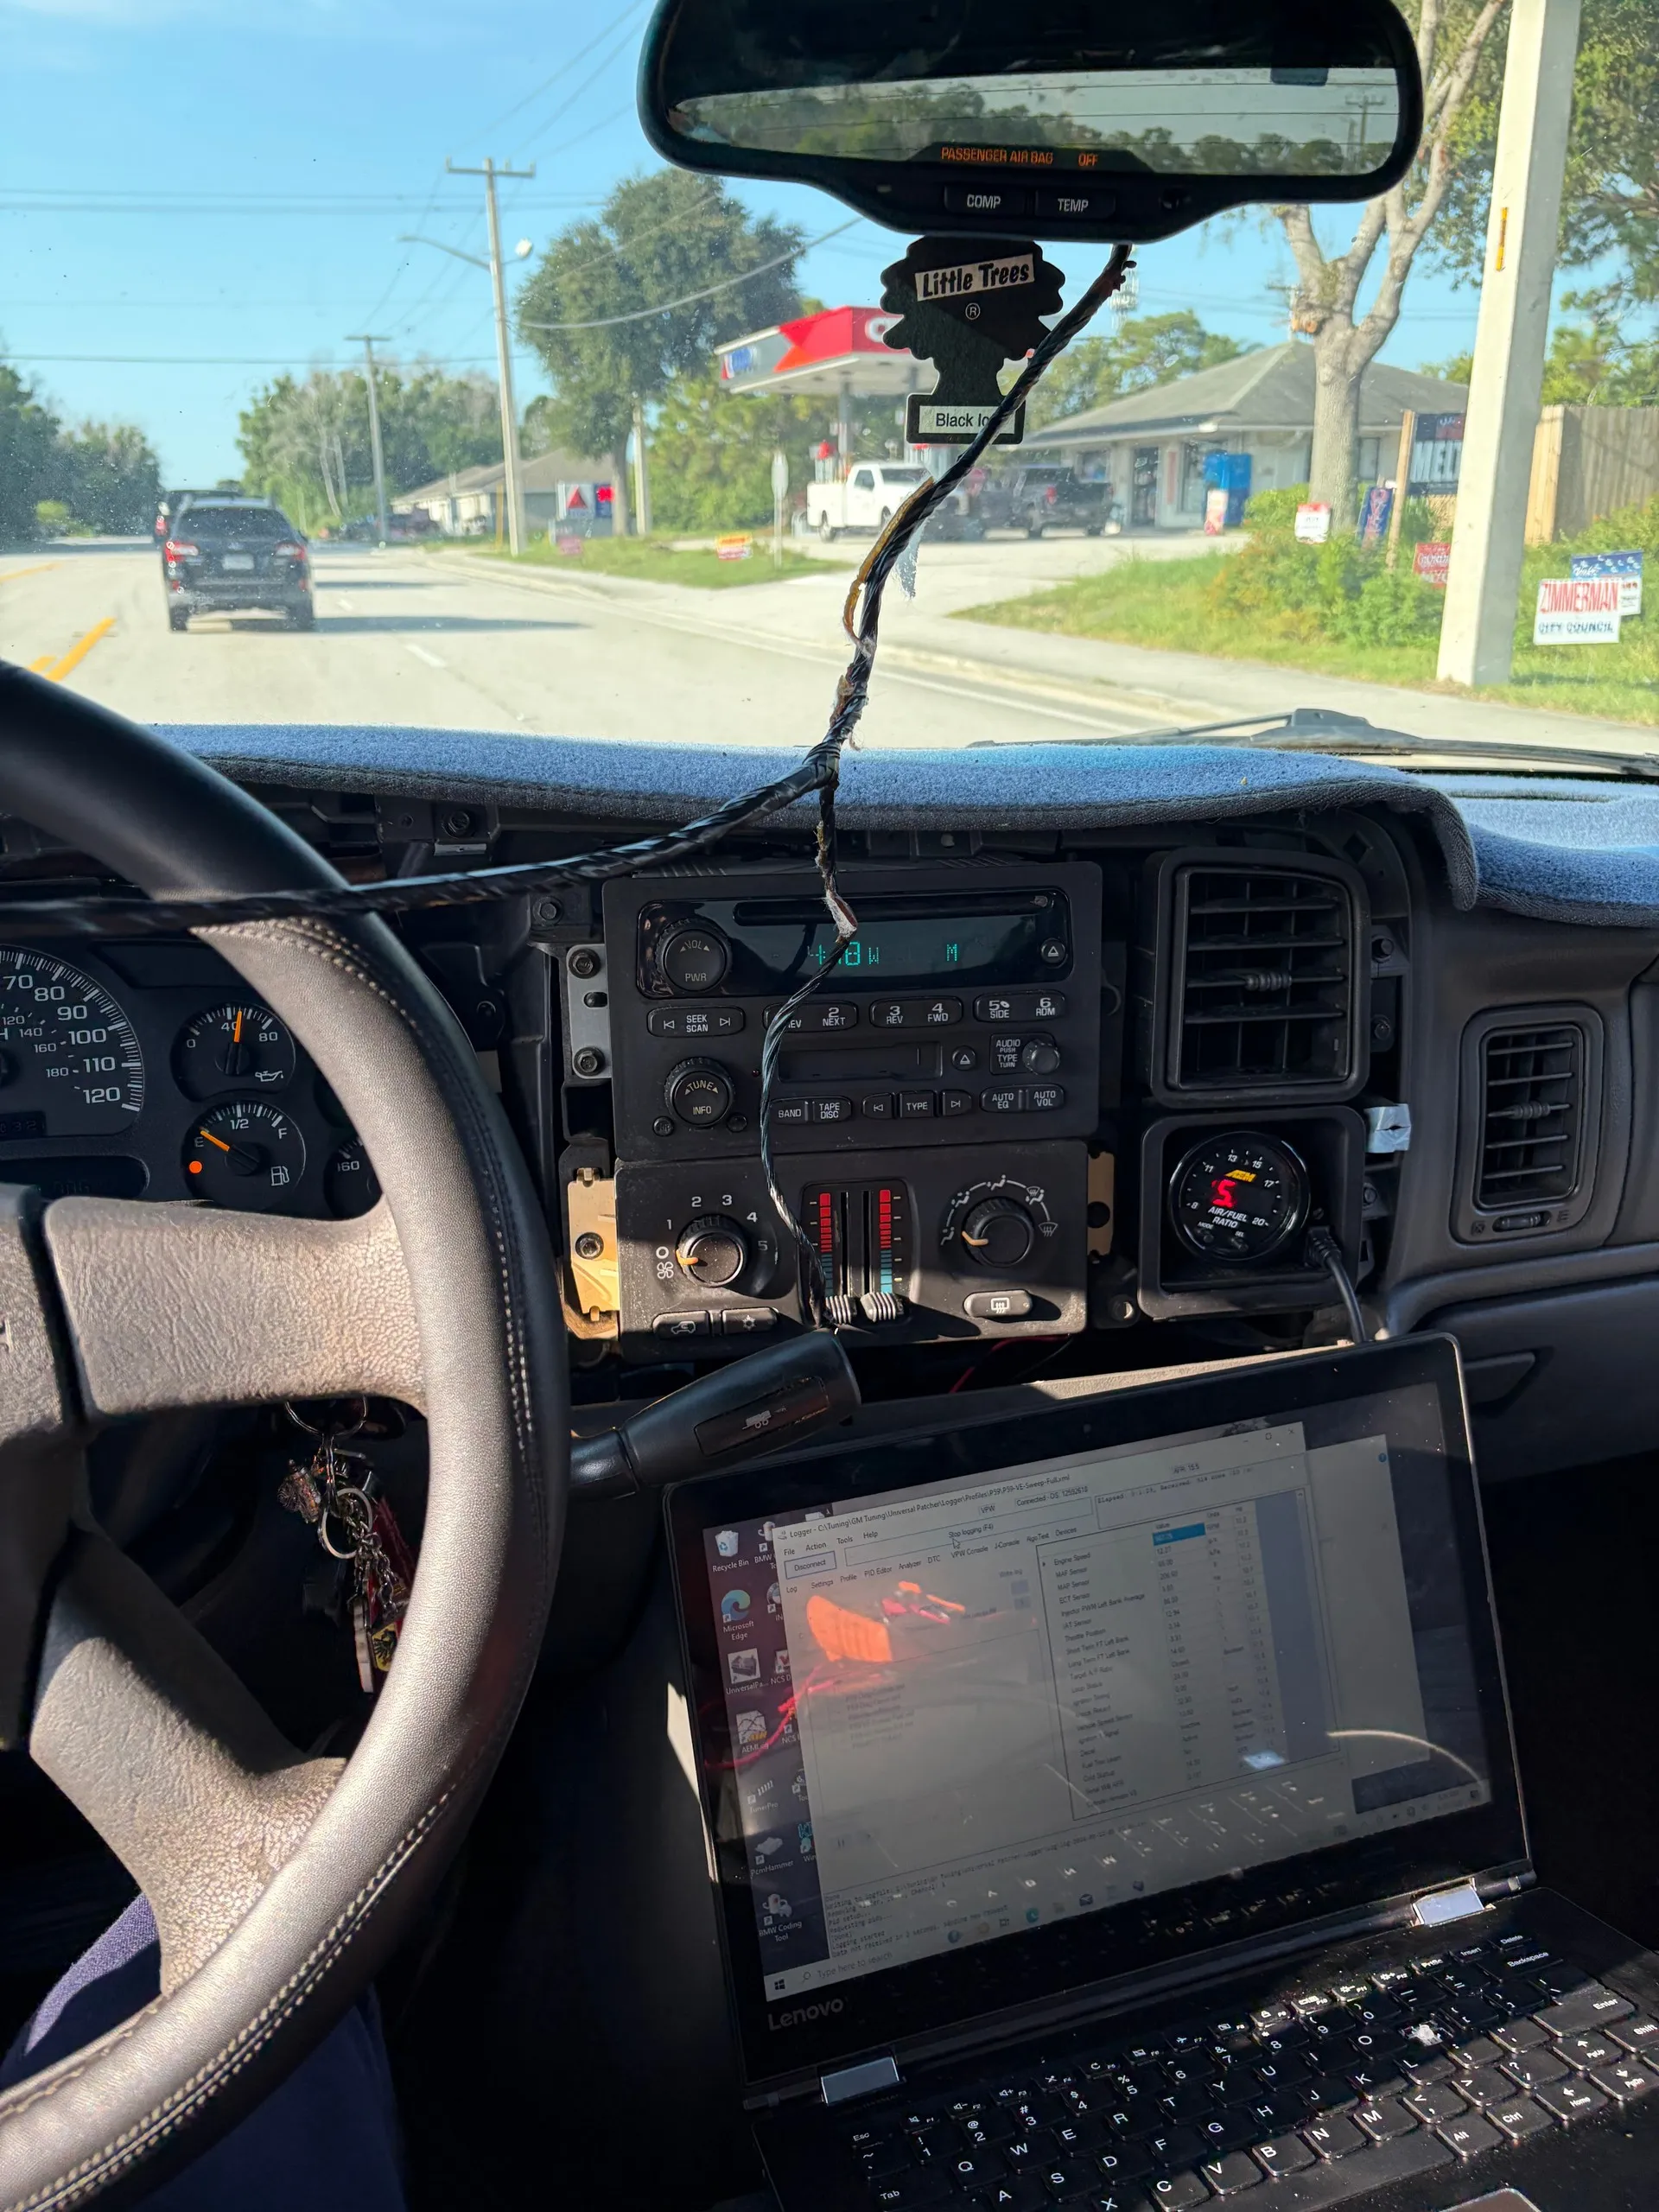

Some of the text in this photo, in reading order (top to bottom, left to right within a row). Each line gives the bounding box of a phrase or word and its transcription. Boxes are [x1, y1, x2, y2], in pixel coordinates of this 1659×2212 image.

[941, 146, 1099, 167] PASSENGER AIR BAG OFF
[966, 194, 1001, 209] COMP
[1057, 198, 1089, 213] TEMP
[923, 263, 1030, 298] Little Trees
[936, 412, 974, 427] Black
[1540, 581, 1619, 614] ZIMMERMAN
[1539, 620, 1615, 635] CITY COUNCIL
[684, 939, 702, 950] VOL
[3, 975, 34, 990] 70
[684, 973, 707, 982] PWR
[34, 986, 65, 1001] 80
[988, 1000, 1000, 1011] 5
[1039, 997, 1052, 1008] 6
[57, 1005, 88, 1020] 90
[828, 1007, 840, 1018] 2
[889, 1006, 901, 1016] 3
[931, 1003, 944, 1014] 4
[1036, 1008, 1056, 1017] RDM
[686, 1014, 707, 1023] SEEK
[886, 1015, 904, 1025] REV
[927, 1013, 949, 1023] FWD
[990, 1010, 1010, 1019] SIDE
[2, 1015, 25, 1026] 120
[823, 1017, 846, 1027] NEXT
[19, 1027, 42, 1038] 140
[686, 1024, 709, 1033] SCAN
[68, 1028, 107, 1046] 100
[258, 1032, 278, 1042] 80
[34, 1043, 57, 1053] 160
[186, 1039, 196, 1048] 0
[995, 1039, 1021, 1048] AUDIO
[83, 1057, 116, 1073] 110
[46, 1067, 69, 1077] 180
[689, 1080, 714, 1092] TUNE
[83, 1087, 121, 1104] 120
[992, 1093, 1014, 1102] AUTO
[1033, 1090, 1056, 1099] AUTO
[819, 1103, 840, 1111] TAPE
[906, 1102, 928, 1111] TYPE
[997, 1101, 1009, 1109] EQ
[1036, 1098, 1053, 1107] VOL
[692, 1105, 712, 1116] INFO
[778, 1109, 802, 1119] BAND
[821, 1110, 840, 1119] DISC
[230, 1119, 250, 1130] 1/2
[278, 1128, 288, 1139] F
[194, 1136, 205, 1147] E
[1227, 1154, 1237, 1162] 13
[337, 1160, 360, 1172] 160
[1252, 1160, 1262, 1169] 15
[1264, 1179, 1274, 1188] 17
[691, 1196, 702, 1207] 2
[721, 1194, 733, 1205] 3
[747, 1212, 758, 1223] 4
[1208, 1206, 1247, 1222] AIR/FUEL
[666, 1219, 672, 1230] 1
[1212, 1217, 1238, 1229] RATIO
[1252, 1217, 1265, 1226] 20
[758, 1240, 768, 1251] 5
[1017, 1493, 1046, 1506] Connected
[981, 1504, 995, 1514] VPW
[790, 1528, 812, 1539] Logger
[949, 1523, 994, 1539] Stop logging (F4)
[784, 1530, 879, 1556] File Action Tools Help
[950, 1546, 988, 1559] VPW Console
[927, 1554, 941, 1564] DTC
[1054, 1556, 1072, 1567] Engine
[713, 1559, 749, 1573] Recycle Bin
[794, 1559, 826, 1572] Disconnect
[898, 1559, 922, 1571] Analyzer
[864, 1565, 893, 1578] PID Editor
[840, 1573, 857, 1583] Profile
[810, 1579, 834, 1591] Settings
[722, 1619, 754, 1634] Microsoft
[731, 1631, 749, 1642] Edge
[750, 1859, 794, 1877] PcmHammer
[758, 1919, 803, 1938] BMW Coding
[775, 1932, 788, 1943] Tool
[1500, 1934, 1523, 1945] Delete
[1460, 1946, 1482, 1957] Insert
[1507, 1950, 1549, 1967] Backspace
[817, 1967, 836, 1979] Type
[837, 1961, 855, 1974] here
[868, 1950, 893, 1967] search
[1592, 1998, 1618, 2010] Enter
[767, 1998, 844, 2031] Lenovo
[1633, 2024, 1659, 2036] Shift
[1586, 2048, 1605, 2059] PgUp
[1261, 2065, 1276, 2076] U
[1355, 2074, 1372, 2085] K
[1624, 2077, 1645, 2089] PgDn
[1212, 2081, 1225, 2092] Y
[1569, 2095, 1591, 2108] Home
[1256, 2105, 1274, 2117] H
[1362, 2110, 1382, 2123] M
[1113, 2113, 1128, 2125] R
[1502, 2112, 1523, 2123] Ctrl
[1208, 2122, 1224, 2133] G
[853, 2132, 870, 2141] Esc
[1062, 2128, 1077, 2140] E
[1312, 2127, 1330, 2141] N
[1453, 2130, 1470, 2141] Alt
[1010, 2143, 1029, 2156] W
[1260, 2145, 1277, 2158] B
[958, 2161, 974, 2172] Q
[1103, 2155, 1117, 2167] D
[1051, 2172, 1065, 2183] S
[1156, 2180, 1172, 2192] C
[880, 2190, 900, 2201] Tab
[999, 2190, 1012, 2202] A
